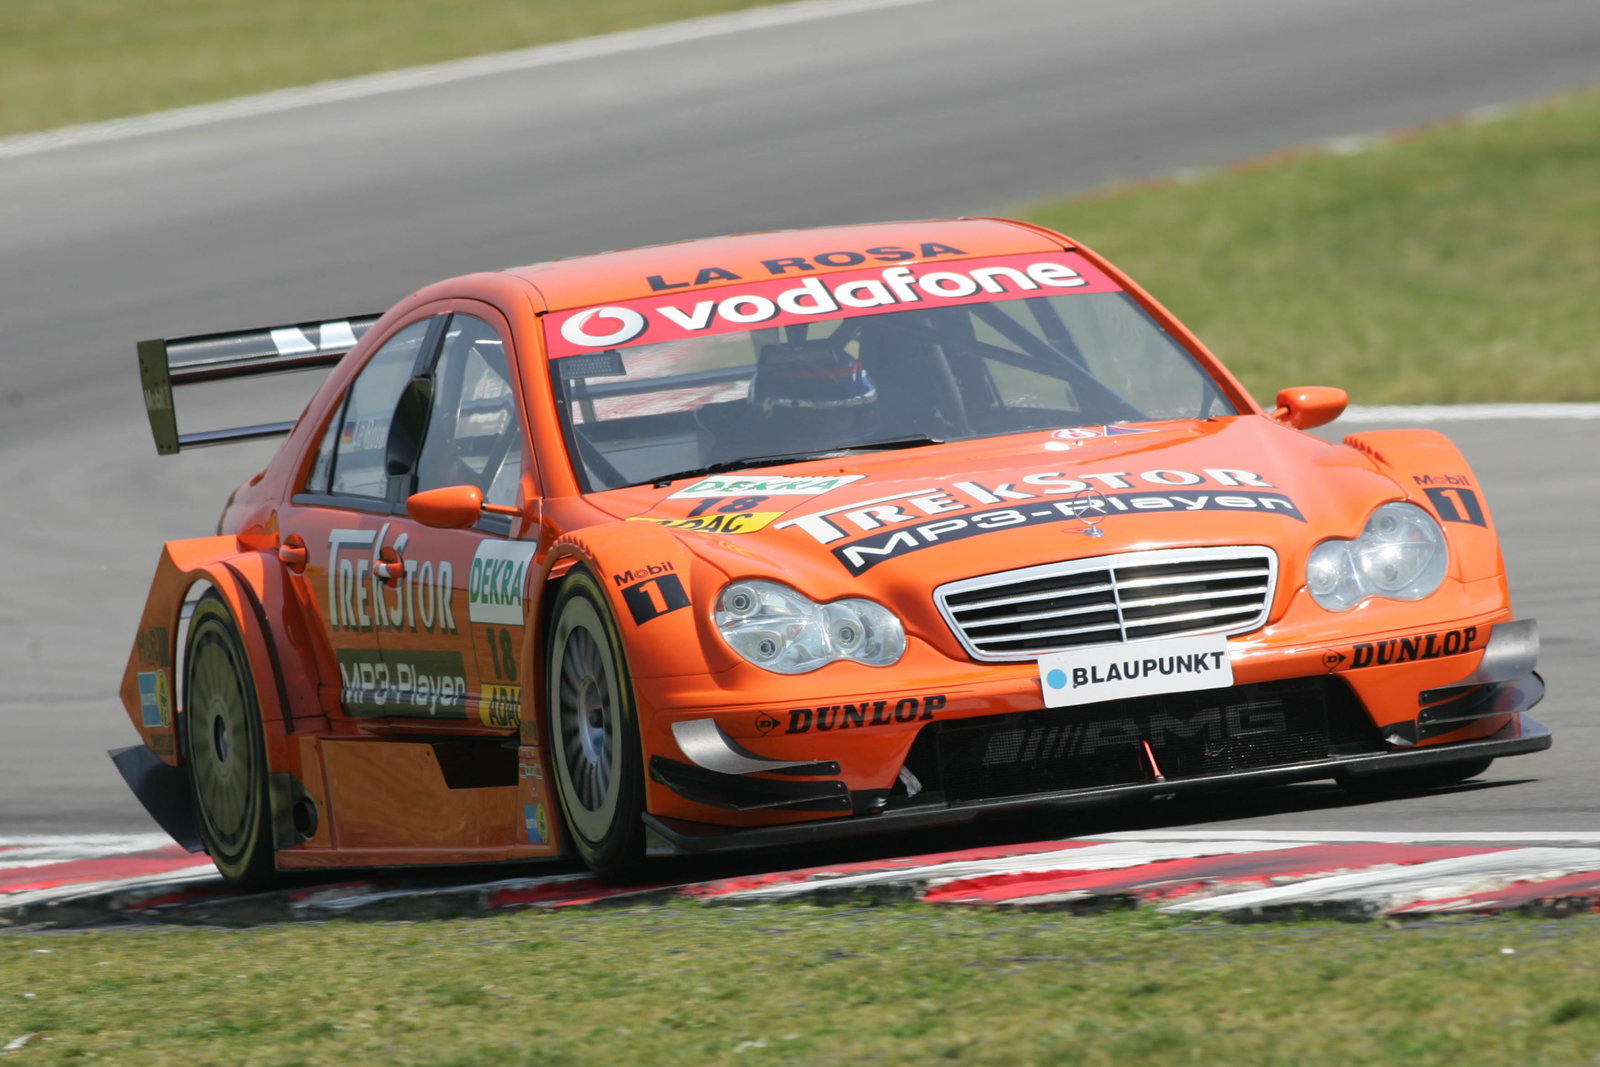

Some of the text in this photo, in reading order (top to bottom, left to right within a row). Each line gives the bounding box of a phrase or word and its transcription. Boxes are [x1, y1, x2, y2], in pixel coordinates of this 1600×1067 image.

[645, 242, 968, 292] LA ROSA
[656, 261, 1088, 331] vodafone
[683, 479, 842, 493] DEKRA
[1412, 475, 1471, 486] Mobil
[656, 513, 754, 533] DAC
[687, 495, 769, 518] 18
[1440, 489, 1472, 522] 1
[470, 557, 525, 607] DEKRA
[614, 561, 675, 587] Mobil
[638, 579, 669, 615] 1
[486, 627, 517, 681] 18
[1350, 626, 1477, 669] DUNLOP
[1072, 650, 1226, 688] BLAUPUNKT
[339, 662, 466, 716] MP3-Player
[784, 694, 947, 735] DUNLOP
